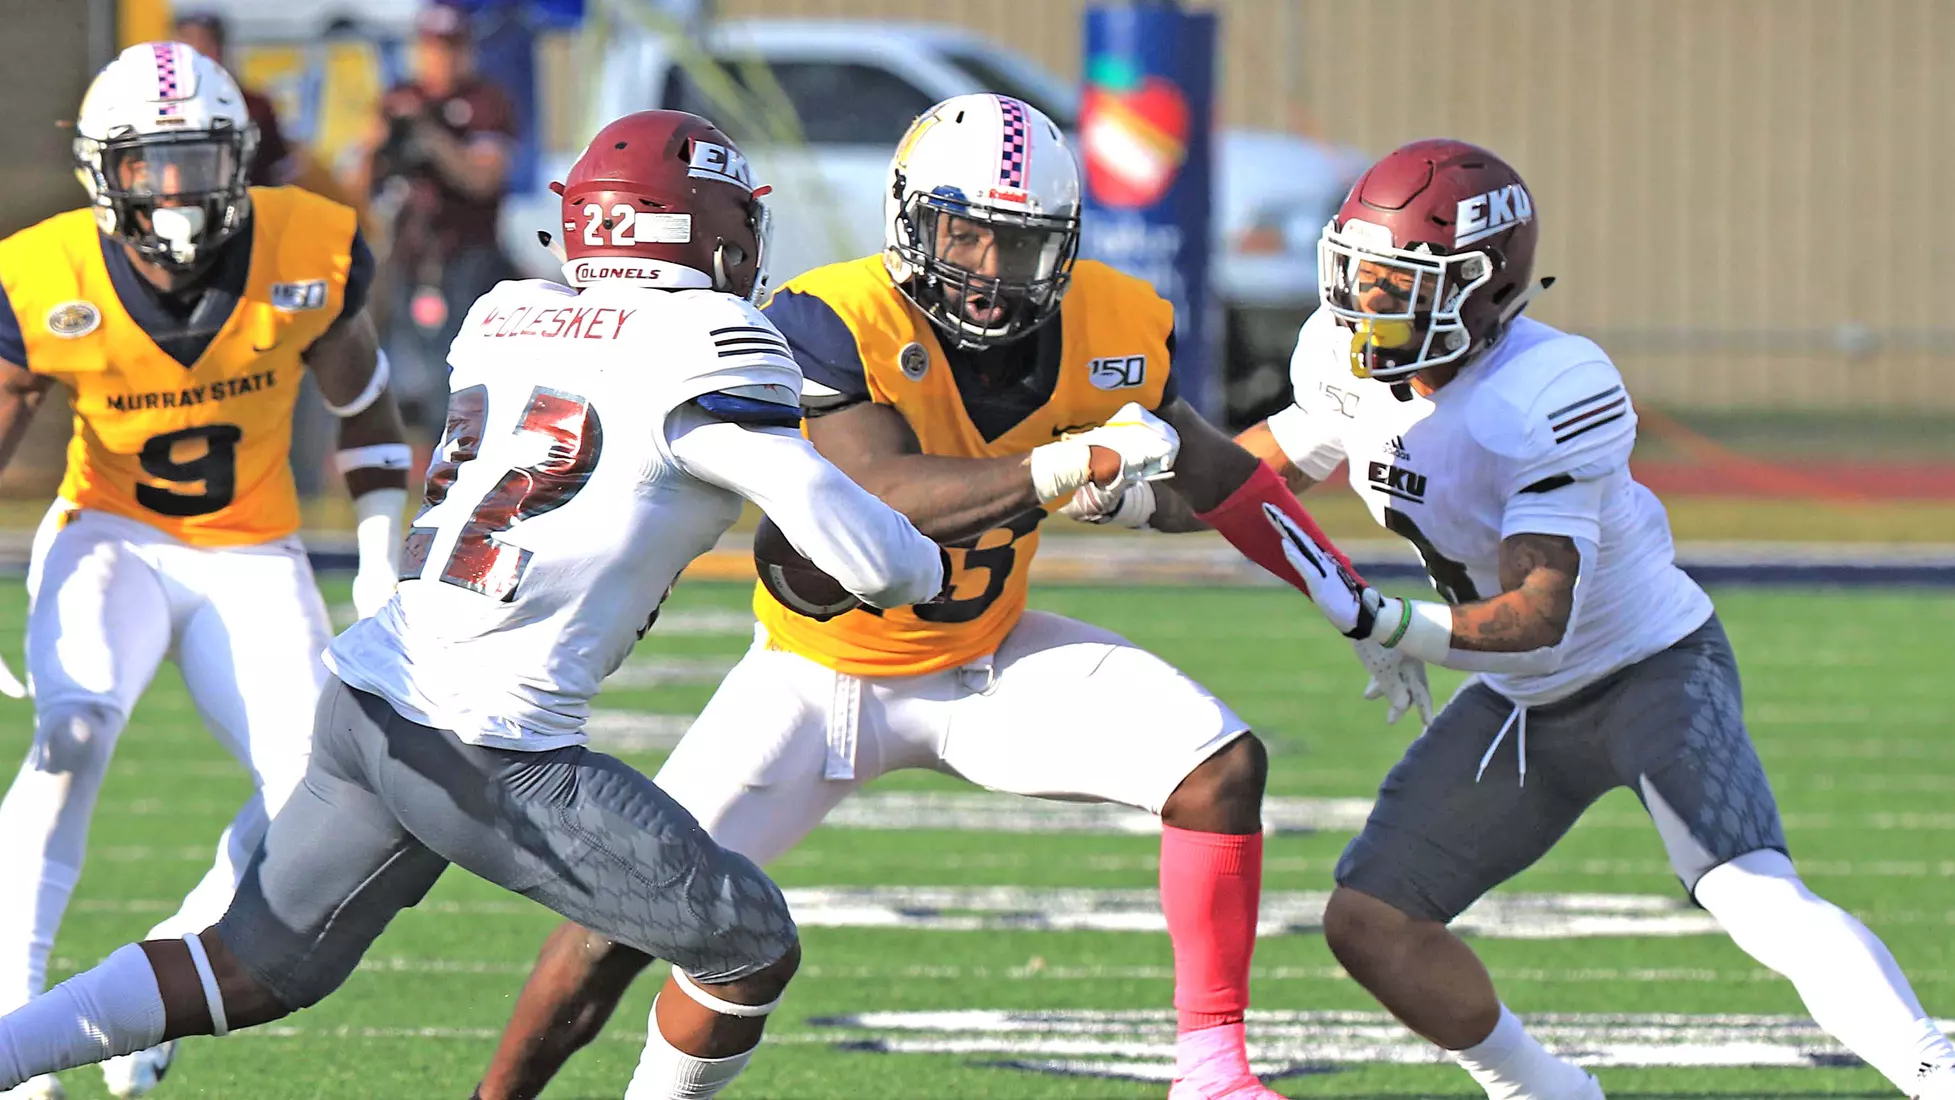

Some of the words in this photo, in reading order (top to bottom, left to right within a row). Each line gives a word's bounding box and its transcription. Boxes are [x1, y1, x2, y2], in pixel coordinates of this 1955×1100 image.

[583, 203, 636, 246] 22
[1455, 184, 1533, 240] EKU
[575, 263, 662, 283] COLONELS
[107, 385, 207, 412] MURRAY
[211, 370, 277, 401] STATE
[1091, 356, 1145, 389] 150
[136, 423, 242, 517] 9
[1368, 461, 1427, 497] EKU
[398, 384, 603, 602] 22
